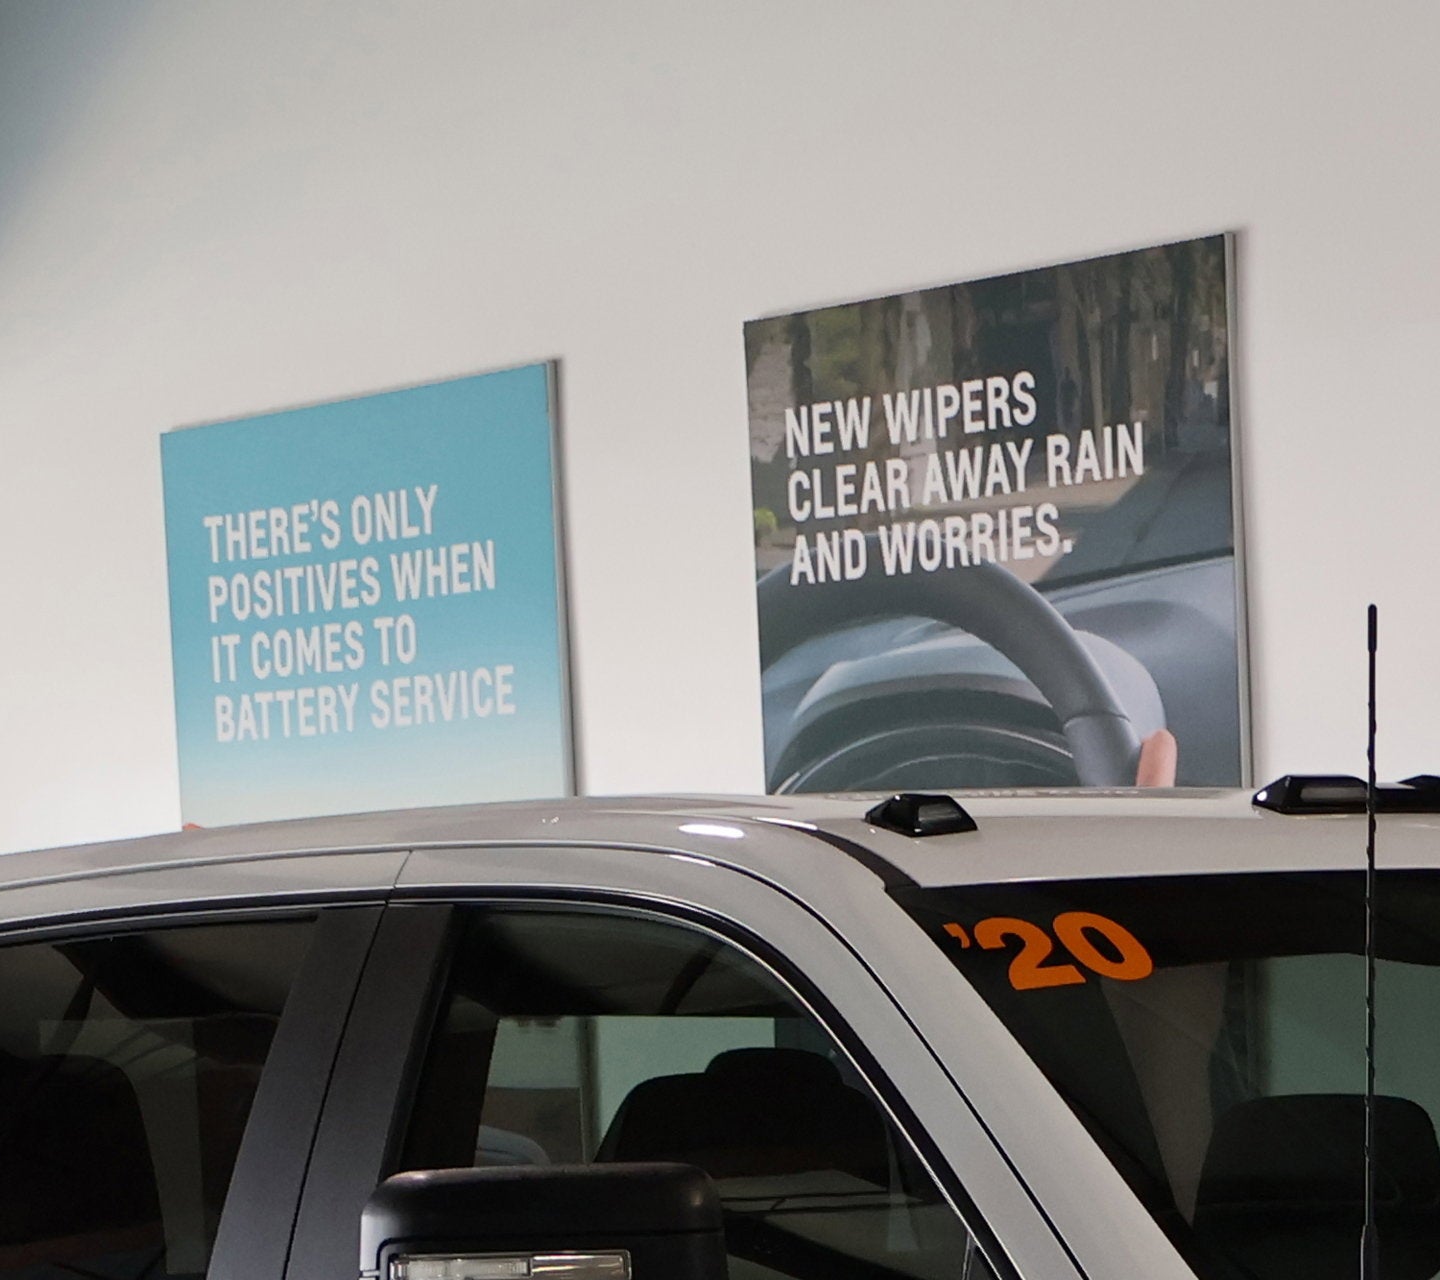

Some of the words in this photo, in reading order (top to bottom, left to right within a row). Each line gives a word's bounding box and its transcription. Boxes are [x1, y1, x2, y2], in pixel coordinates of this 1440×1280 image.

[784, 396, 872, 459] NEW
[882, 370, 1038, 446] WIPERS
[787, 457, 910, 523] CLEAR
[922, 438, 1034, 507] AWAY
[1046, 421, 1145, 489] RAIN
[203, 498, 342, 563] THERE'S
[351, 484, 438, 545] ONLY
[789, 527, 868, 586] AND
[877, 502, 1074, 577] WORRIES.
[208, 555, 381, 623] POSITIVES
[390, 538, 496, 602] WHEN
[211, 633, 241, 684] IT
[250, 620, 366, 680] COMES
[373, 613, 417, 665] TO
[213, 682, 359, 743] BATTERY
[370, 664, 517, 729] SERVICE
[942, 911, 1154, 991] '20
